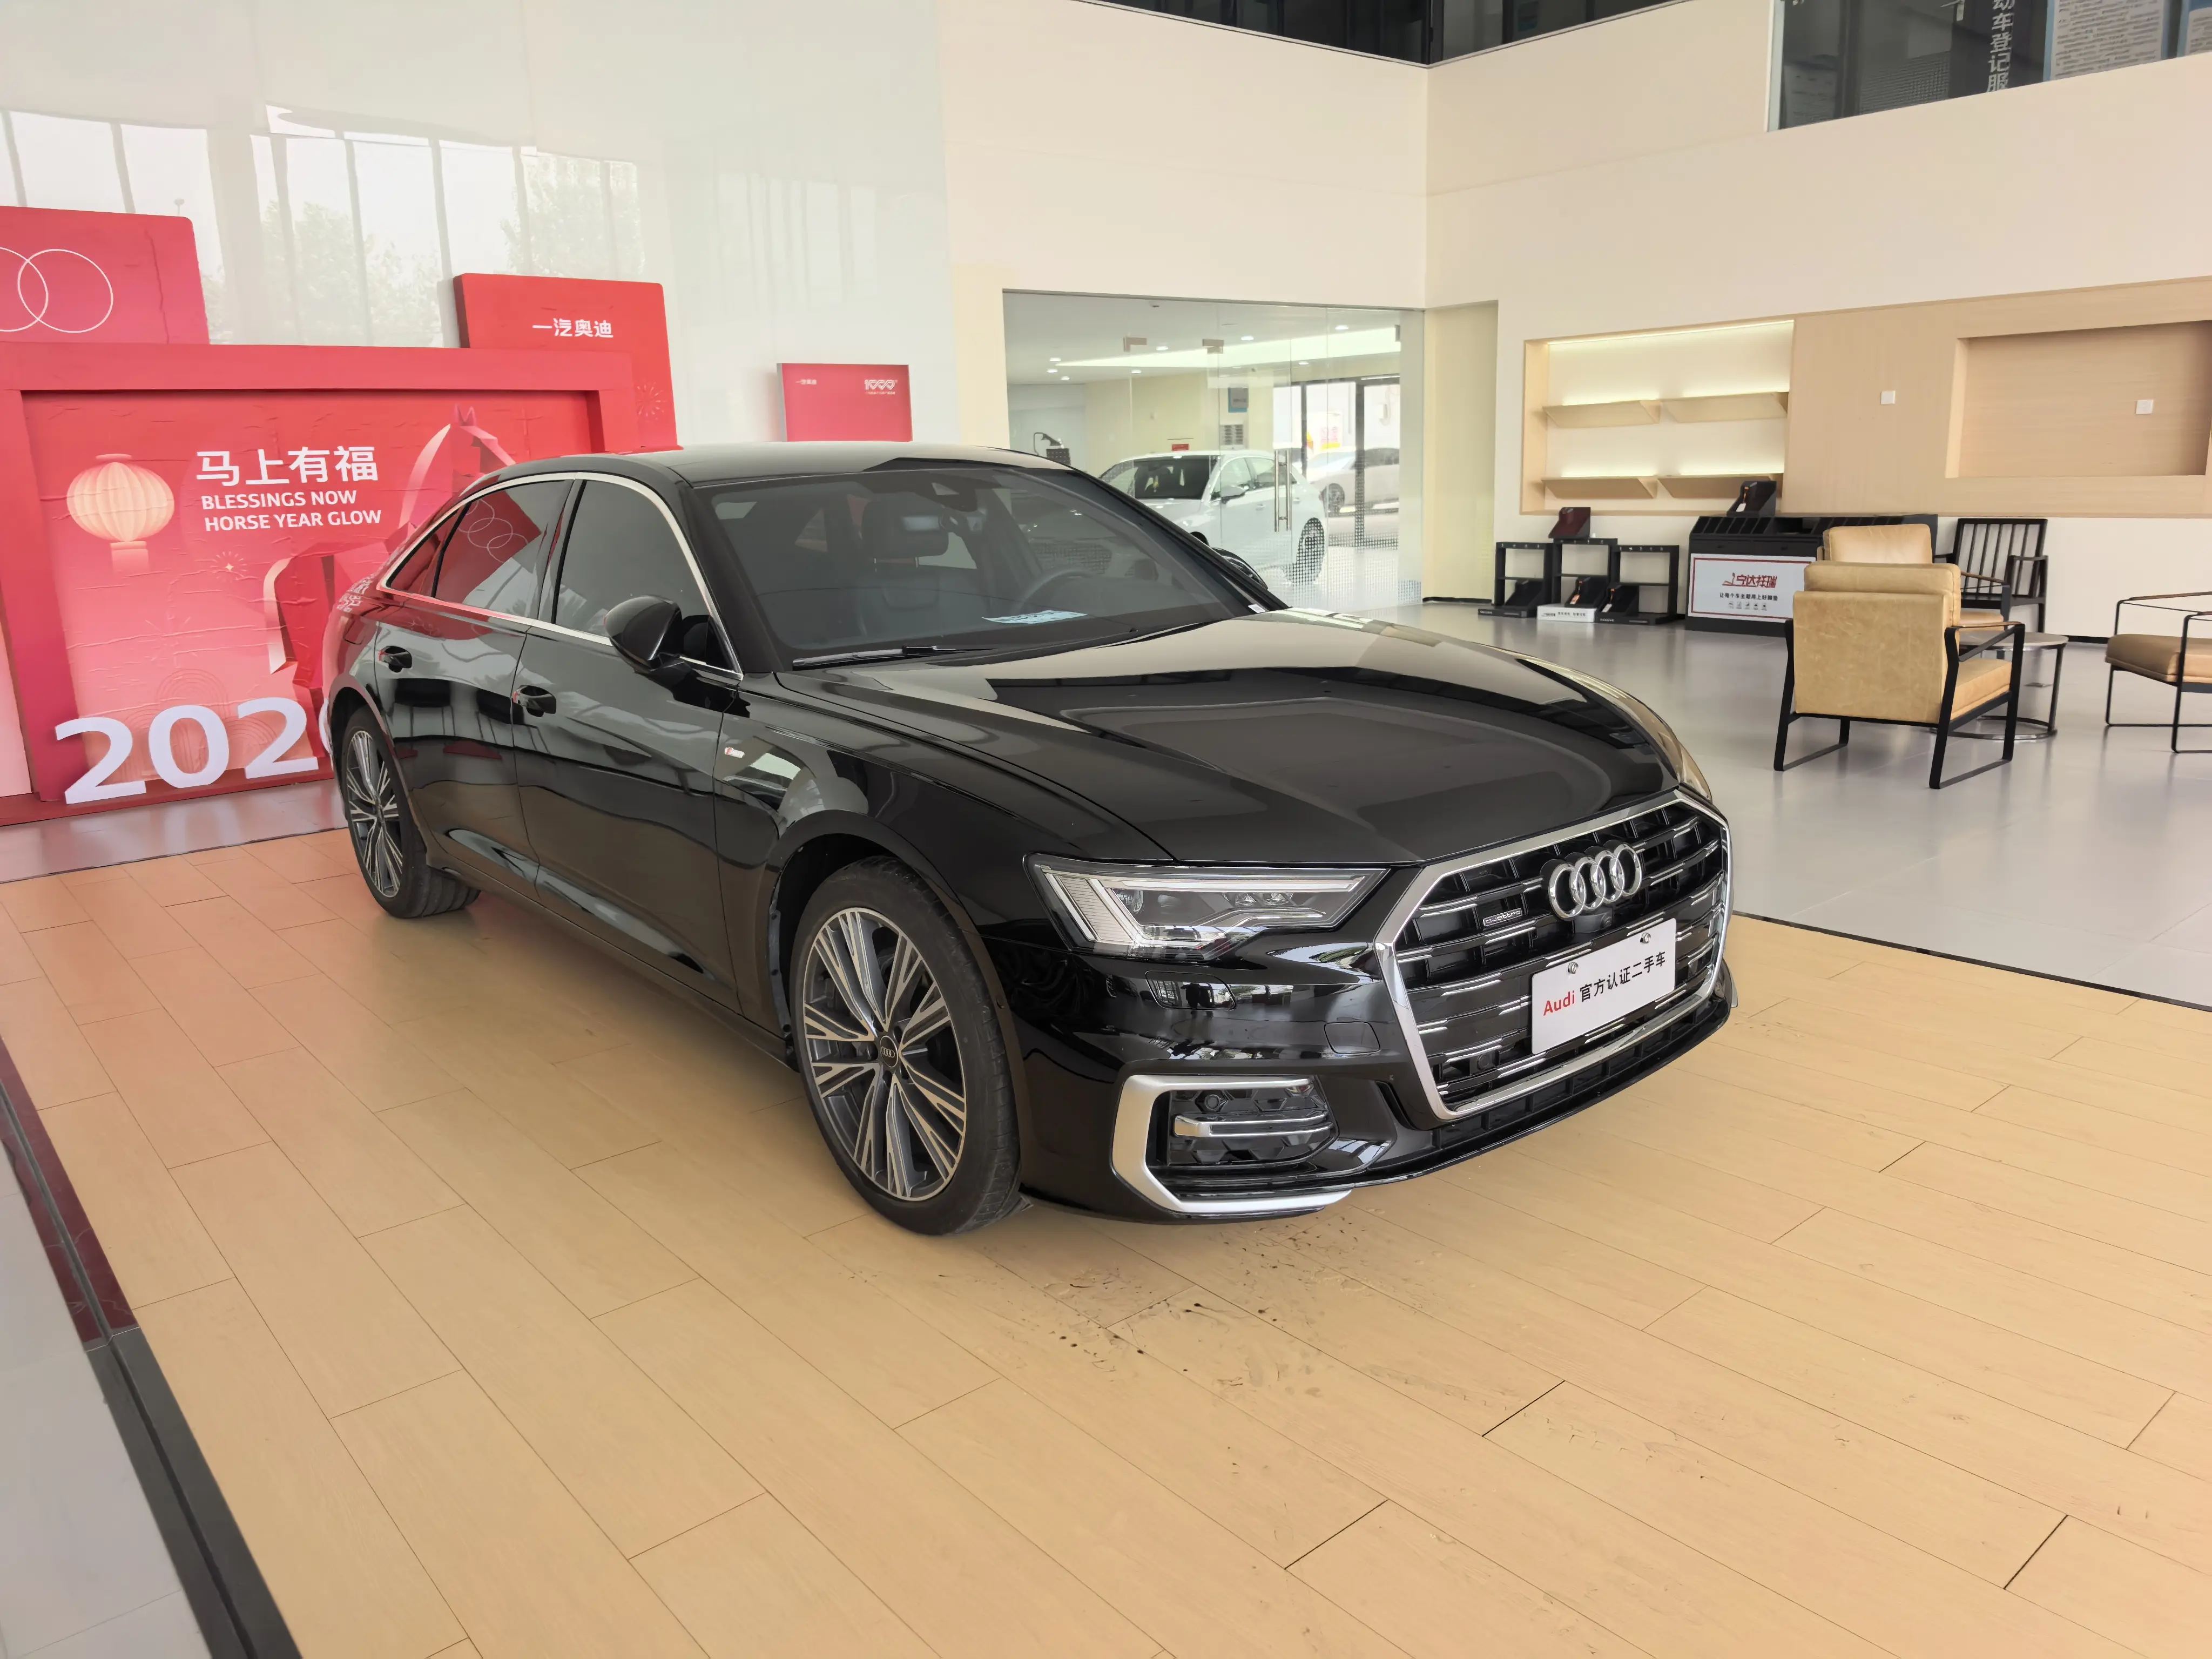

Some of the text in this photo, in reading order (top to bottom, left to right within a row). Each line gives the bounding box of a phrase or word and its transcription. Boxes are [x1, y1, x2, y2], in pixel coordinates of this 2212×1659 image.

[532, 318, 613, 338] 一汽奥迪
[196, 446, 378, 487] 马上有福
[201, 490, 357, 510] BLESSINGS NOW
[205, 510, 381, 531] HORSE YEAR GLOW
[55, 697, 335, 804] 202
[1486, 911, 1521, 924] quattro
[1543, 952, 1665, 1016] Audi 官方认证二手车
